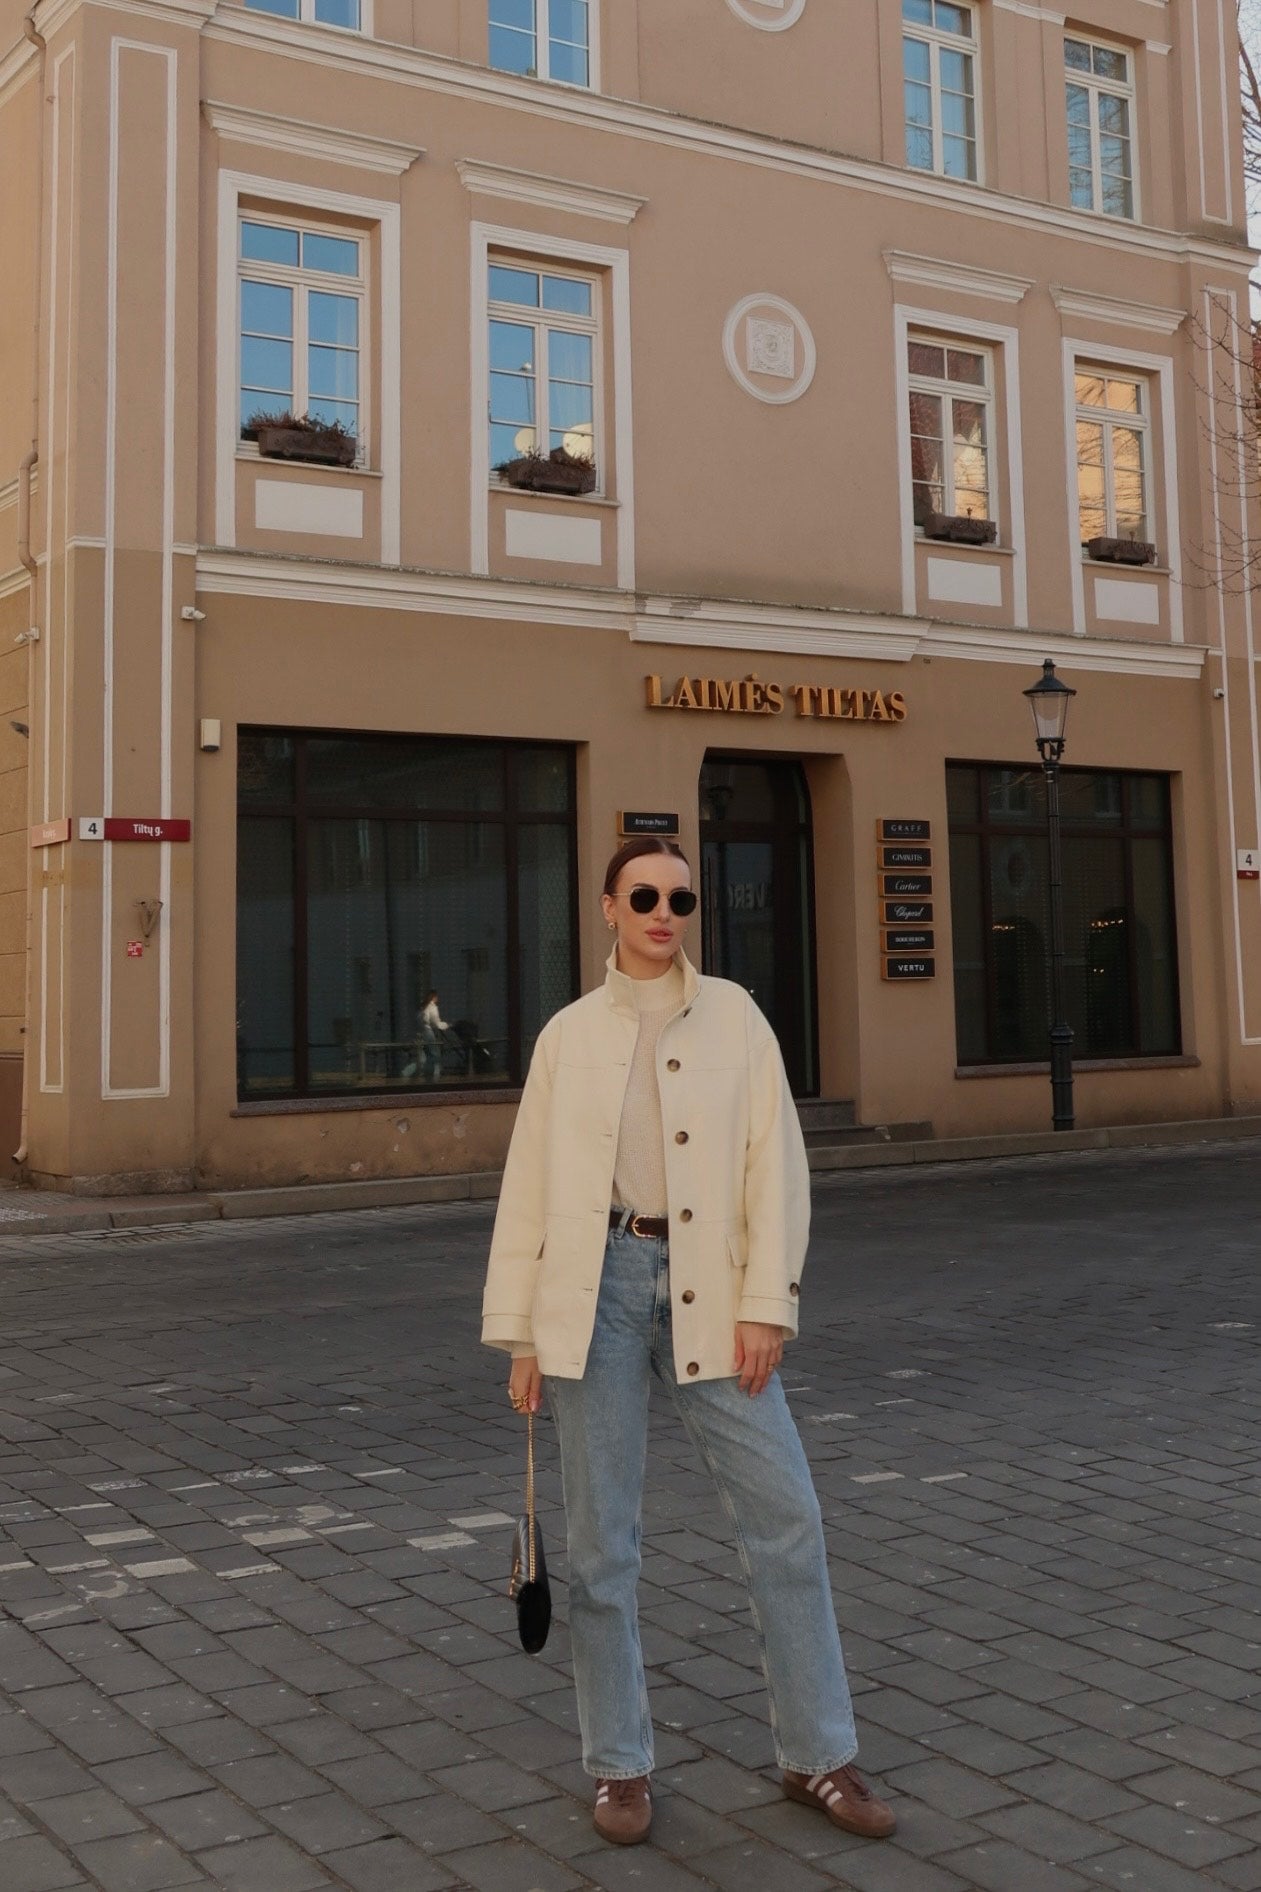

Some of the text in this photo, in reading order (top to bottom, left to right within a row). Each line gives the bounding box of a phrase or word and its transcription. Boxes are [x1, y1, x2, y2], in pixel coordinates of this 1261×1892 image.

[646, 673, 908, 722] LAIMĖS TILTAS
[88, 823, 97, 835] 4
[133, 824, 163, 837] Tiltų g.
[890, 824, 922, 832] GRAFF
[1245, 854, 1252, 866] 4
[895, 880, 921, 892] Cartier
[897, 964, 925, 972] VERTU
